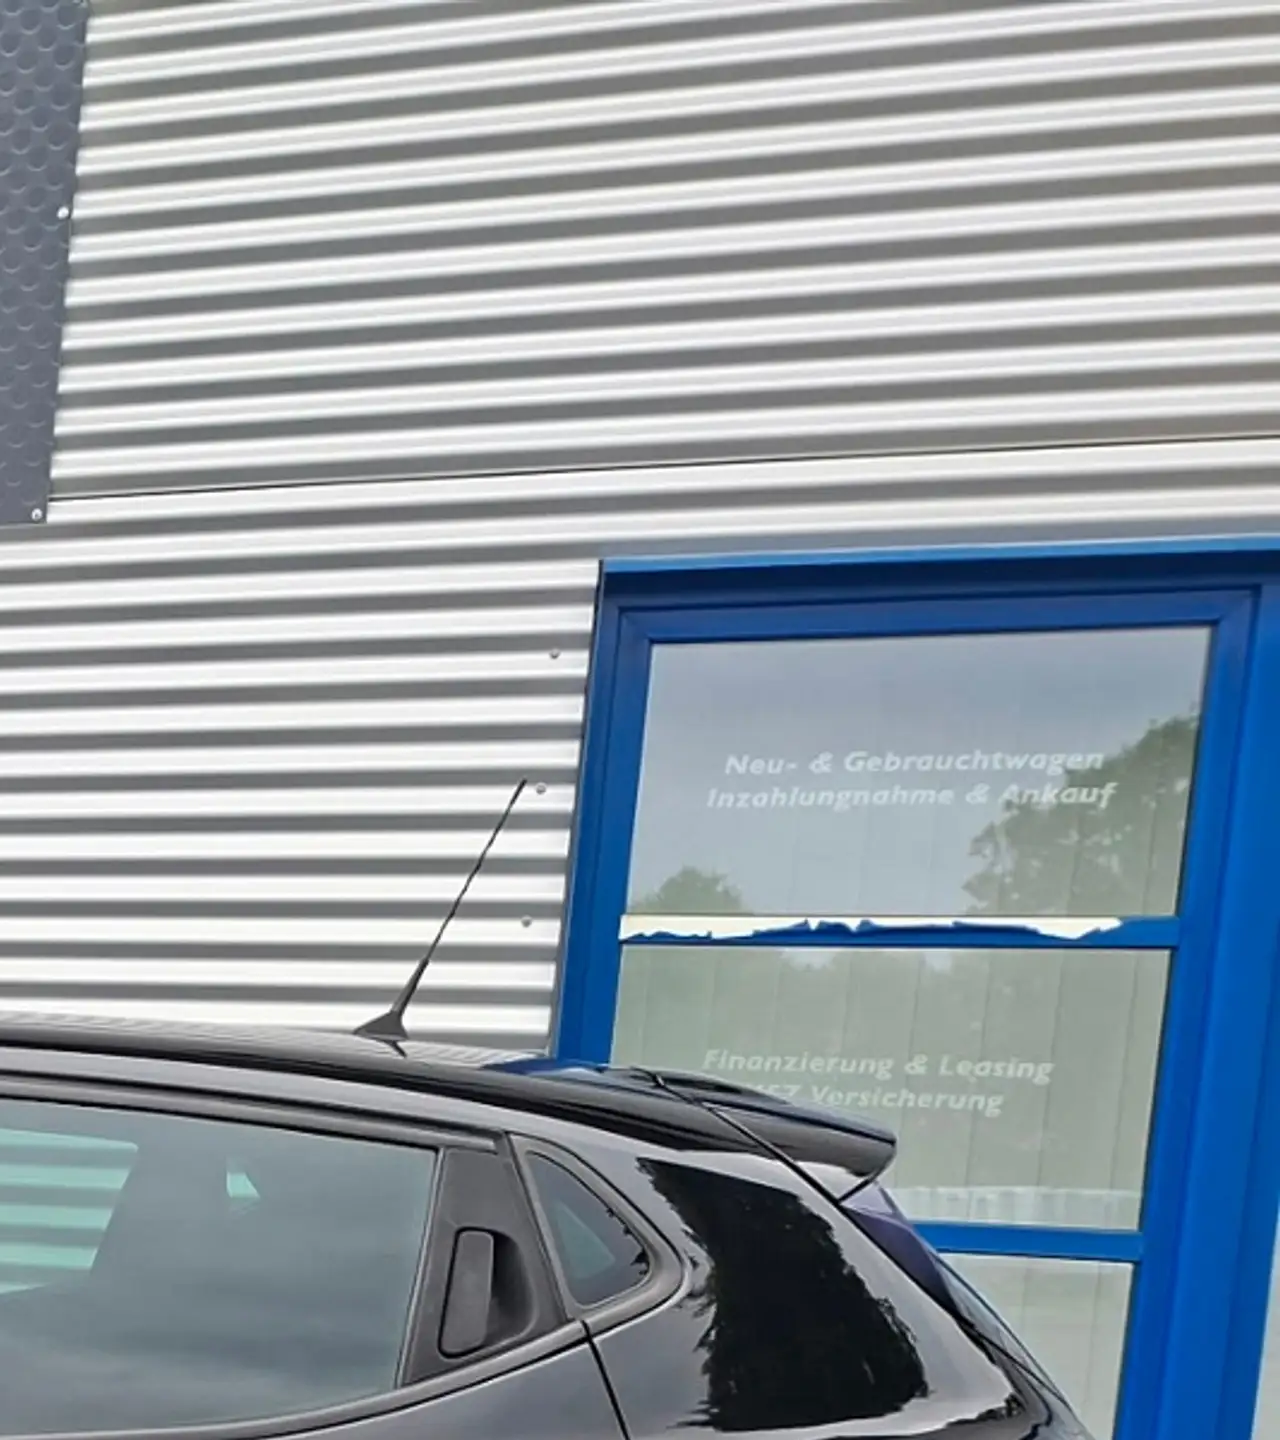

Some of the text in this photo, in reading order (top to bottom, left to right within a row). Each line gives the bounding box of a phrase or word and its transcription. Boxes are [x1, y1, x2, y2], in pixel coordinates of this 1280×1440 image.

[725, 749, 1105, 777] Neu- & Gebrauchtwagen
[706, 781, 1120, 813] Inzahlungnahme & Ankauf
[701, 1049, 1055, 1084] Finanzierung & Leasing
